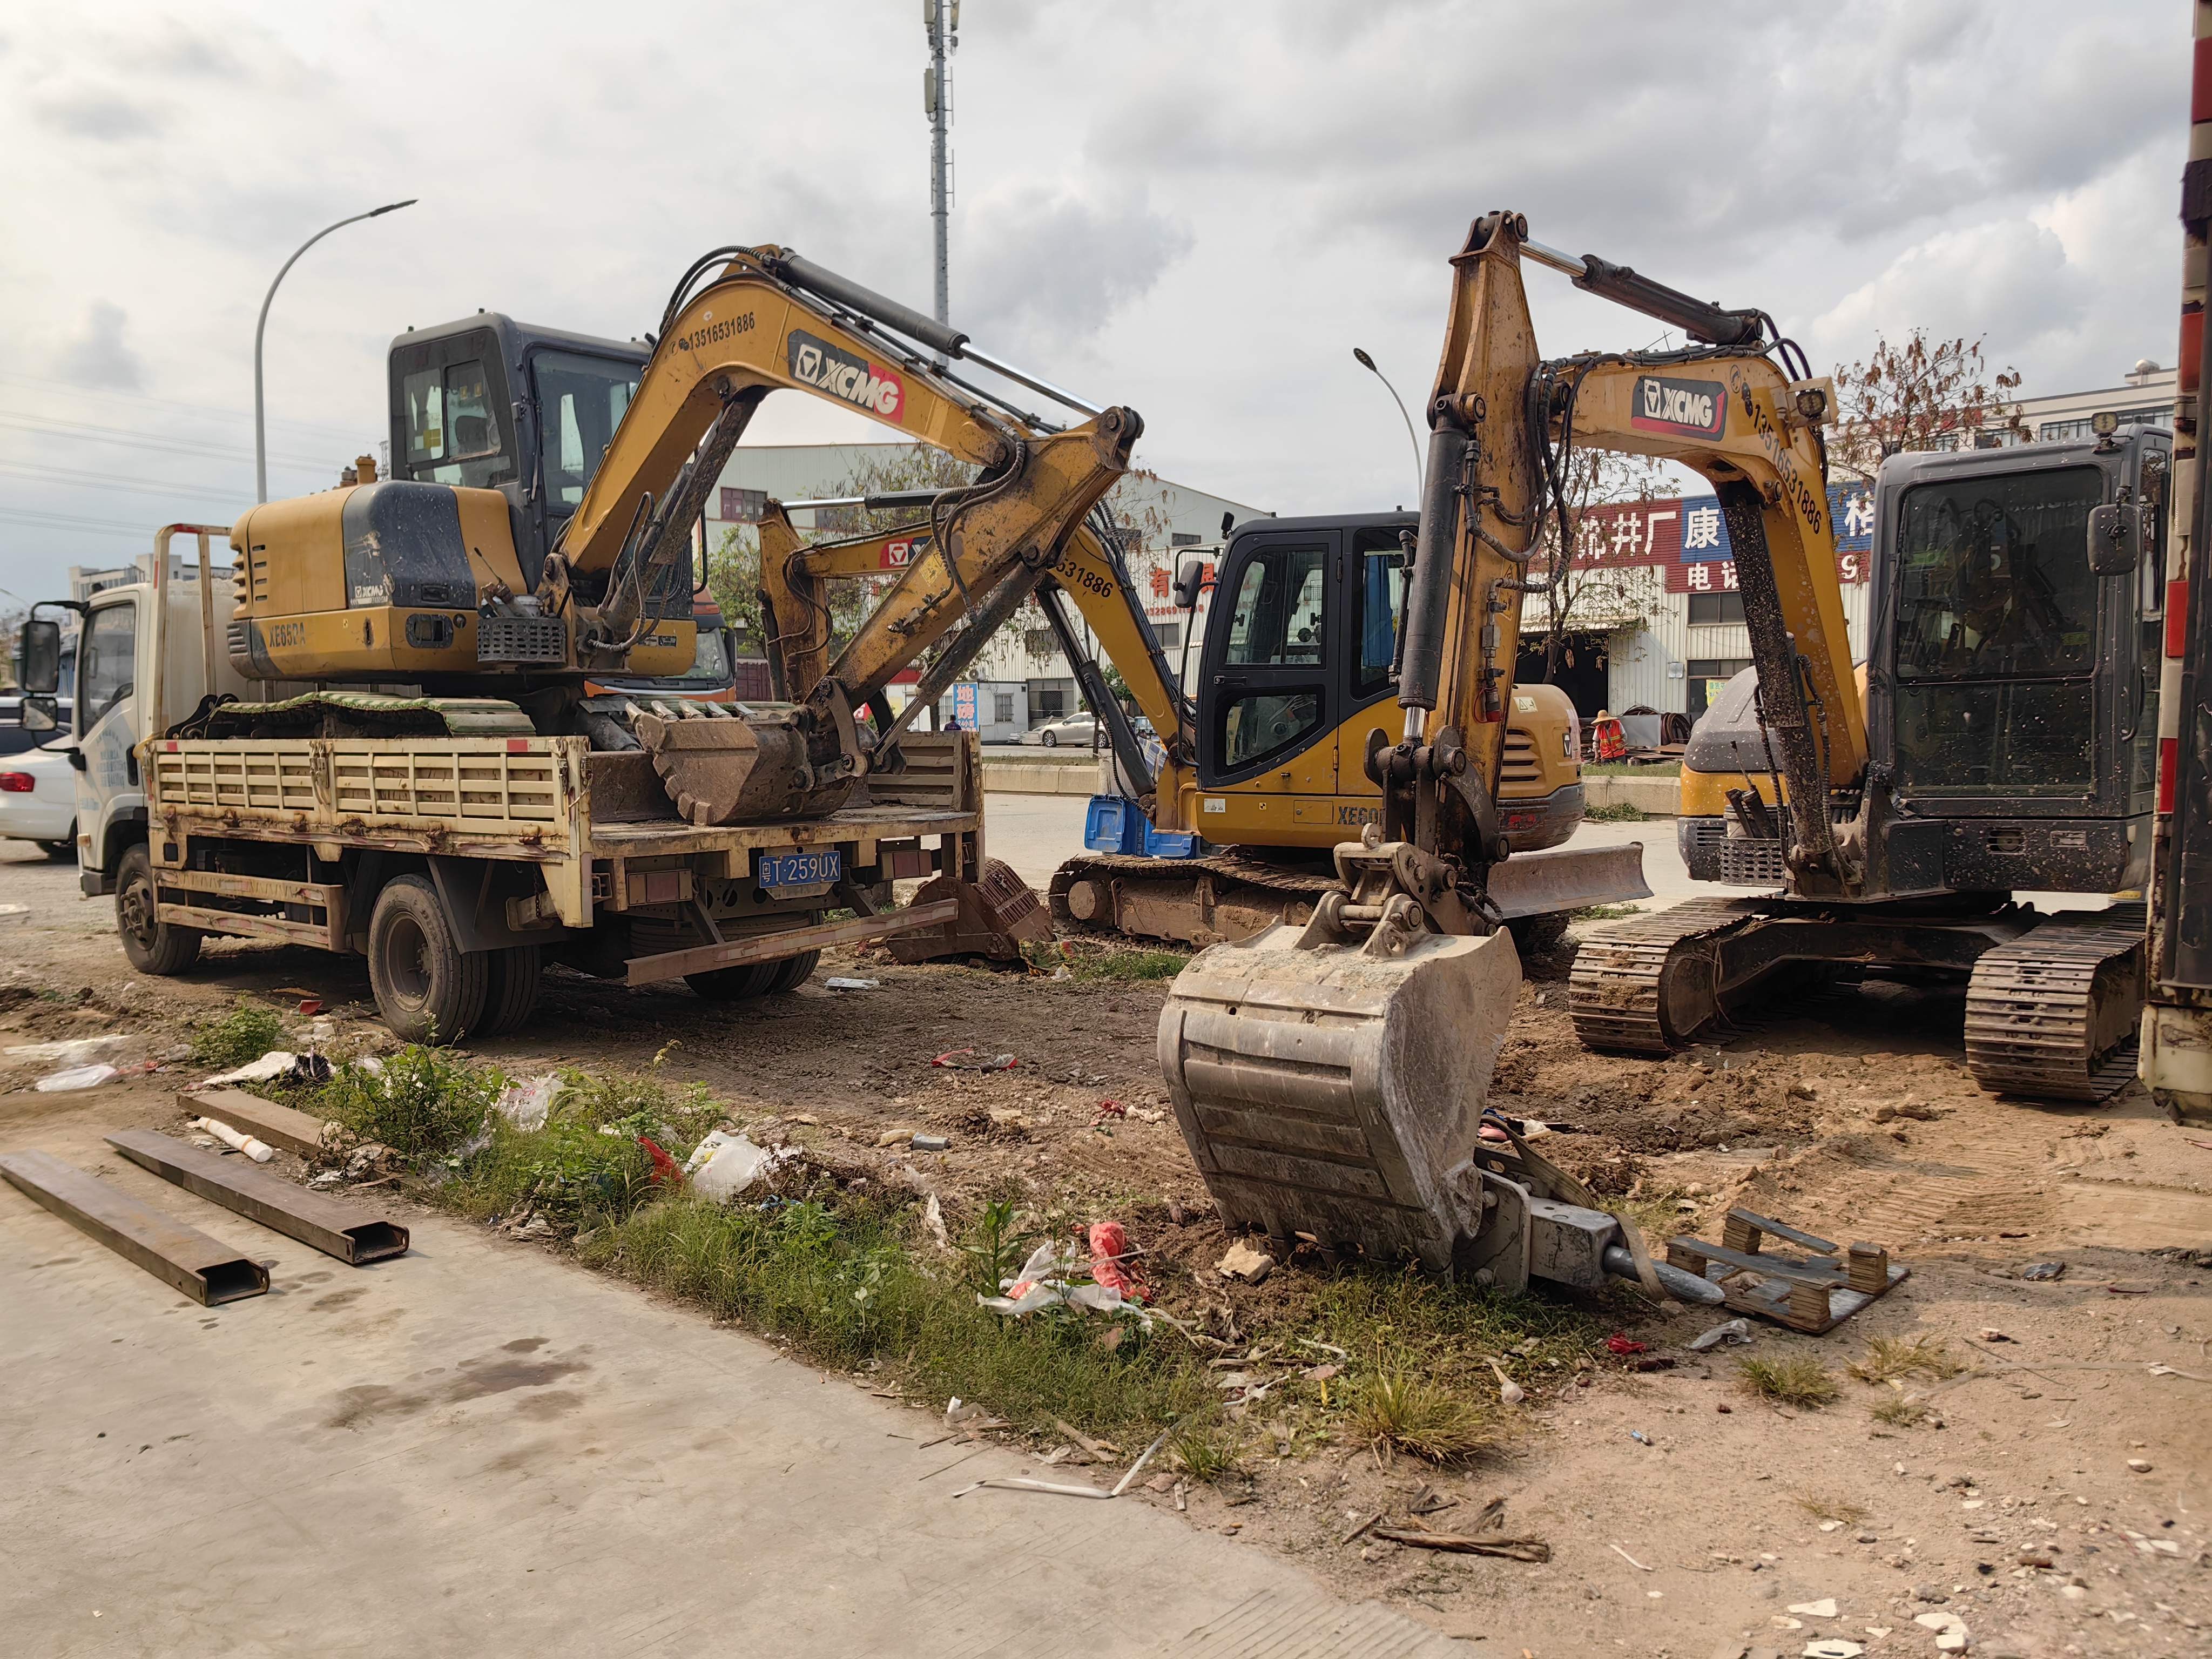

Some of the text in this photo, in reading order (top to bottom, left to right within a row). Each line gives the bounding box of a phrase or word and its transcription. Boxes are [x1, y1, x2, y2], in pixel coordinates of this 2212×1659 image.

[689, 311, 755, 350] 13516531886
[815, 356, 899, 415] XCMG
[1660, 387, 1713, 428] XCMG
[1684, 507, 1720, 549] 康
